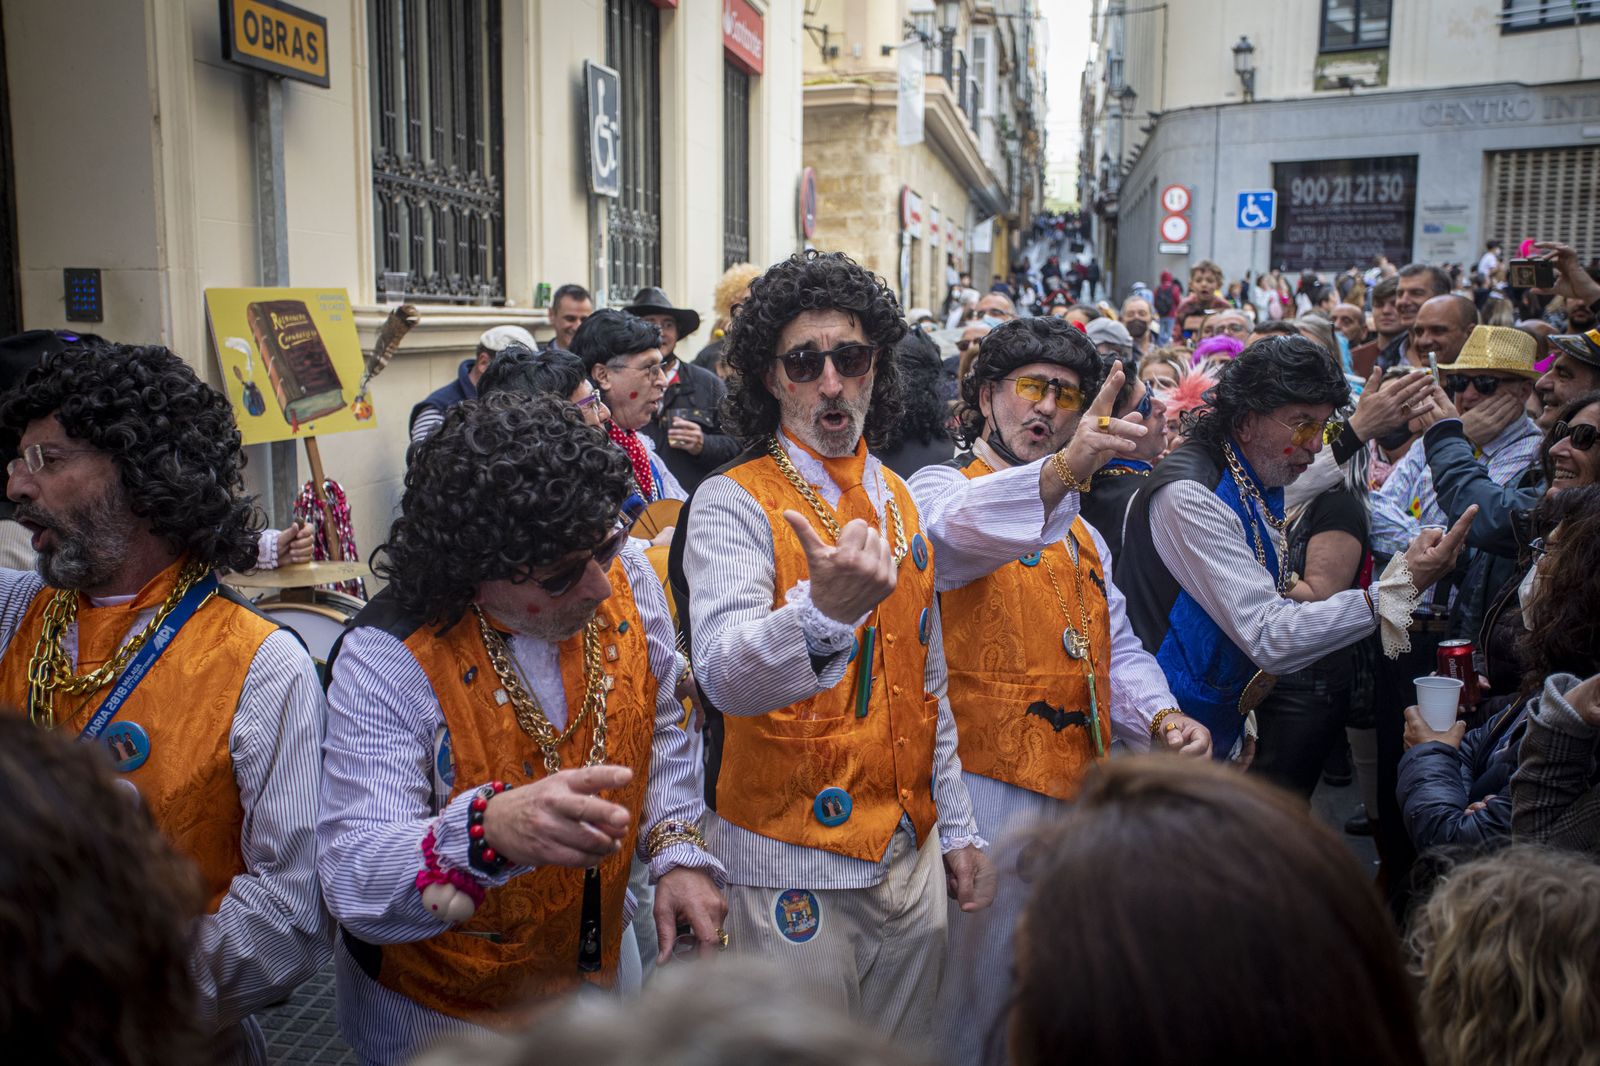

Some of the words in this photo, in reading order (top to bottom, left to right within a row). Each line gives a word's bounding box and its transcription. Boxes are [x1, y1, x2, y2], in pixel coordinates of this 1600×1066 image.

[243, 9, 318, 65] OBRAS
[1420, 95, 1536, 127] CENTRO
[1291, 176, 1328, 206] 900
[1331, 175, 1351, 204] 21
[1354, 174, 1374, 203] 21
[1378, 172, 1404, 202] 30
[105, 686, 128, 711] 2018
